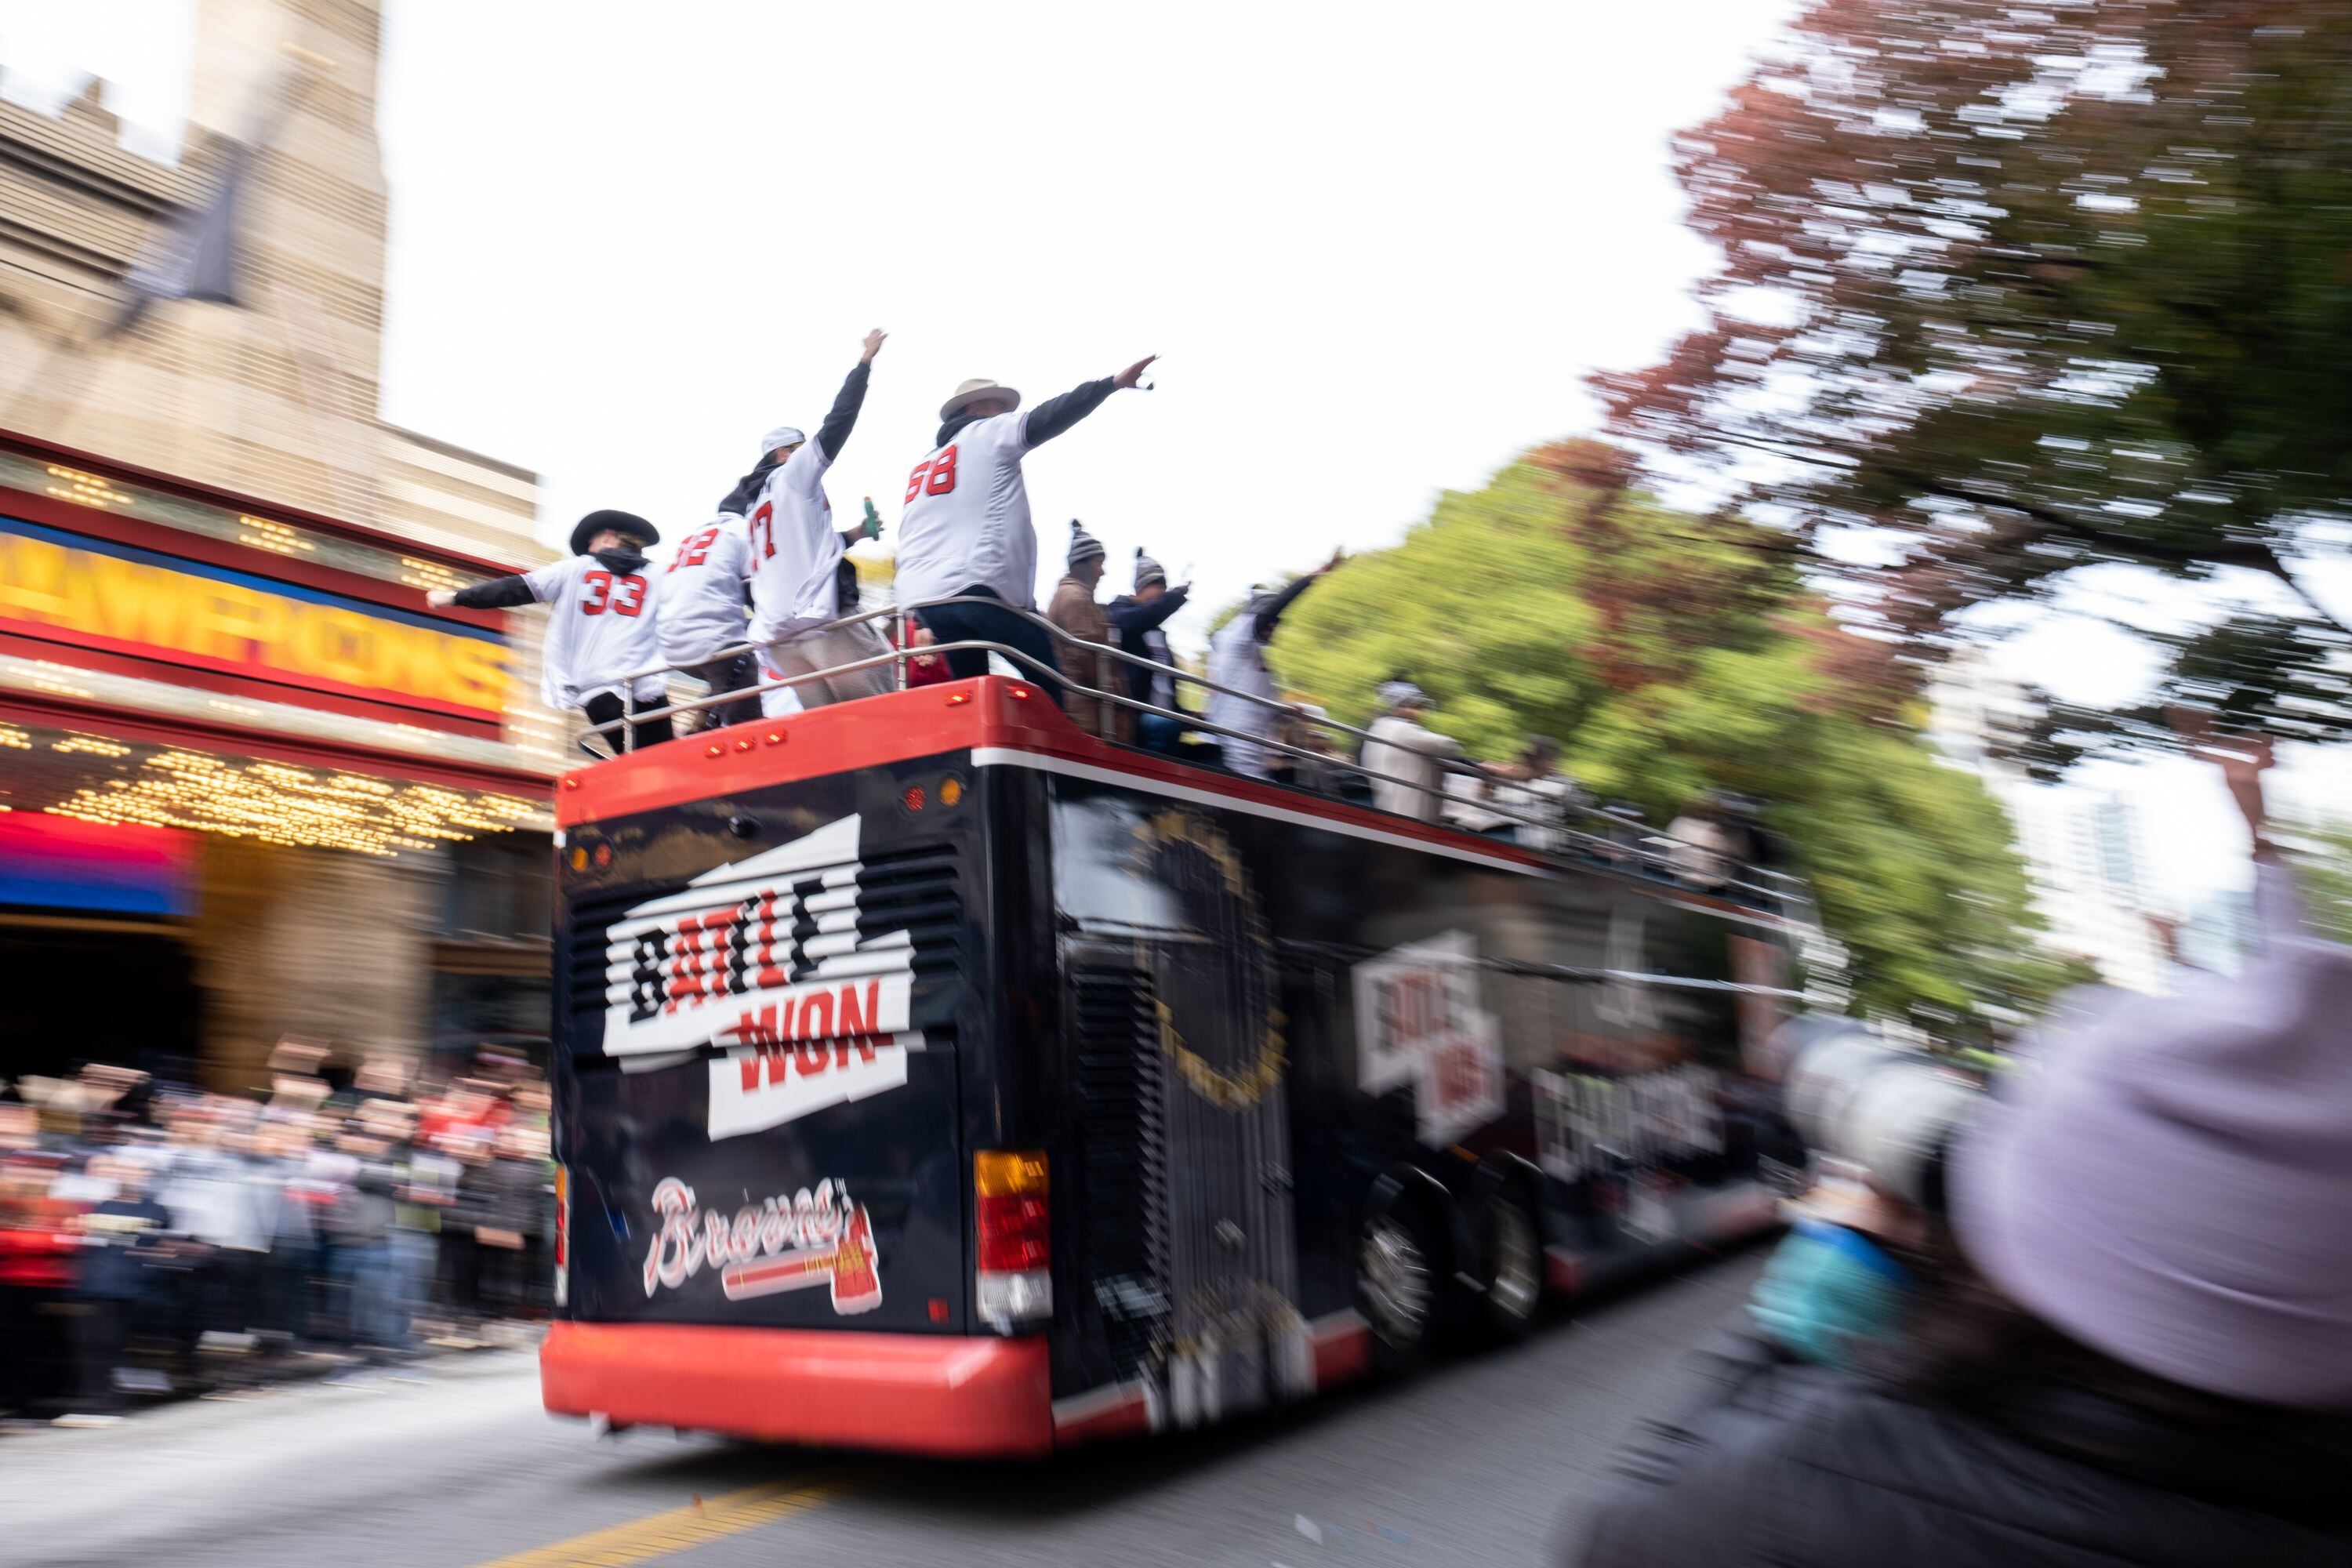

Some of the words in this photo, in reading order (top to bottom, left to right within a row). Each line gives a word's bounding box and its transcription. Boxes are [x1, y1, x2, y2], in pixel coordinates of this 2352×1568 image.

[749, 499, 776, 573] 7
[583, 570, 648, 617] 33
[630, 876, 833, 1025] BATTLE
[738, 975, 894, 1093] WON
